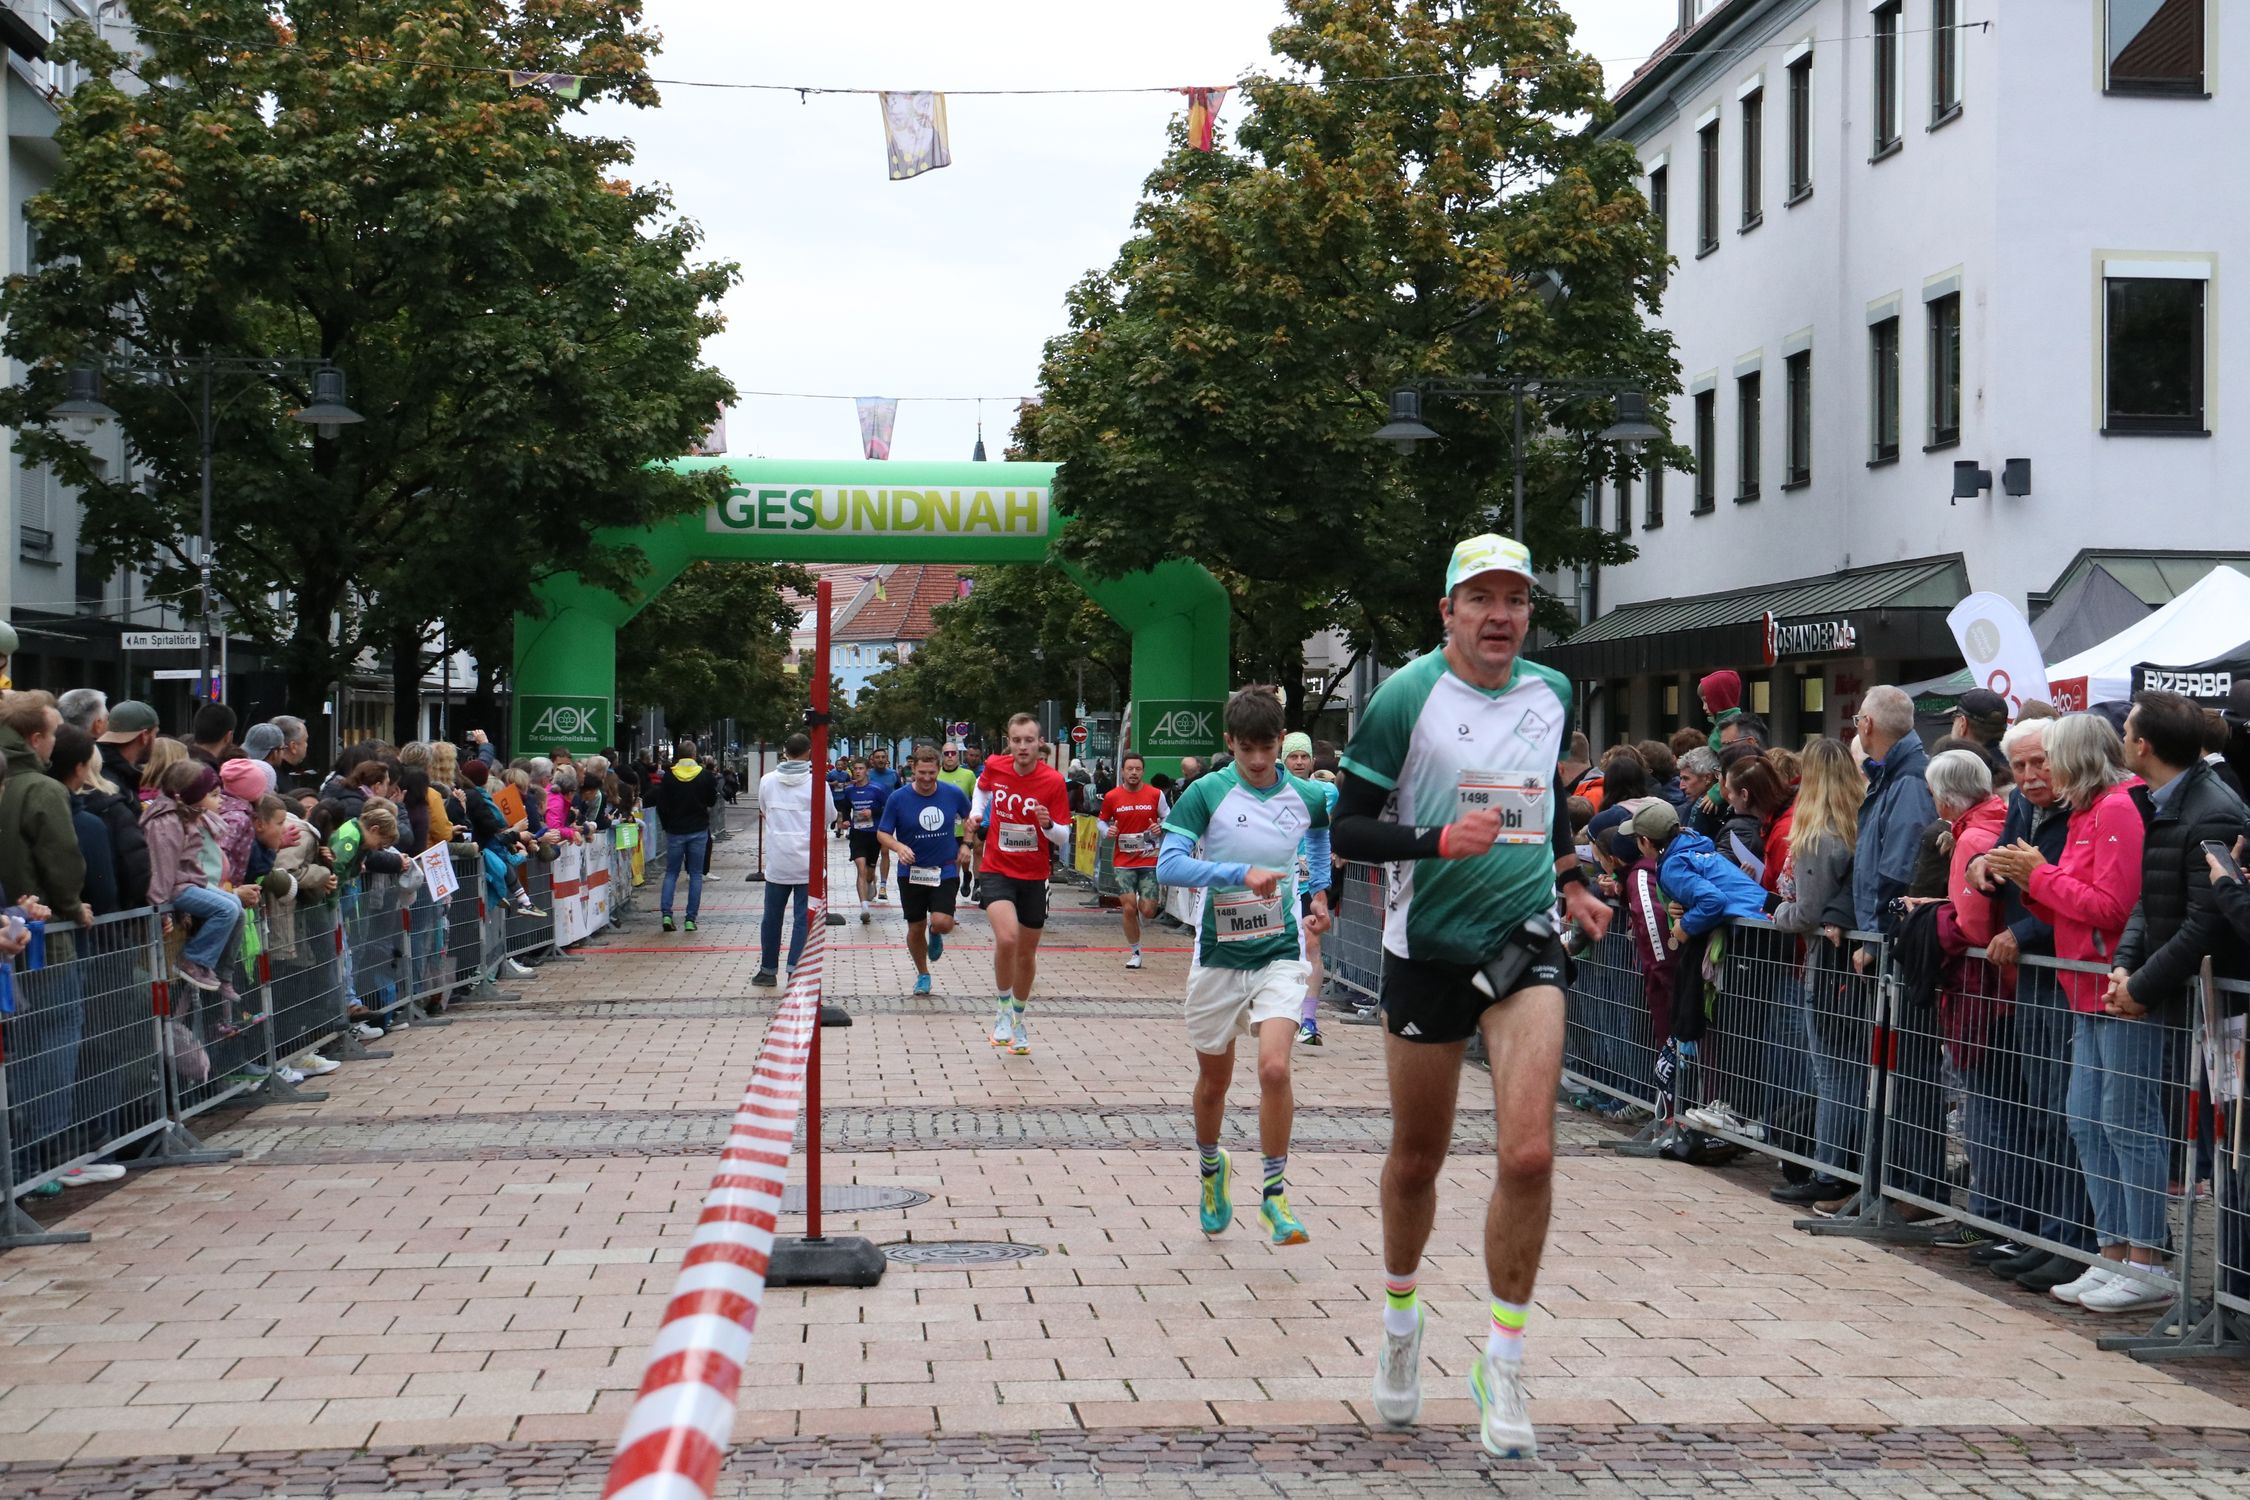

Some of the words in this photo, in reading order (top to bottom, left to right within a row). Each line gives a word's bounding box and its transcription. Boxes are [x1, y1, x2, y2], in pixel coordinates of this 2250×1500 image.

[717, 487, 1038, 532] GESUNDNAH
[133, 635, 147, 645] Am
[151, 635, 197, 648] Spitaltörle
[2143, 670, 2231, 697] BIZERBA
[531, 706, 597, 734] AOK
[1150, 710, 1214, 738] AOK
[529, 734, 539, 742] Die
[1461, 792, 1489, 804] 1498
[1003, 837, 1032, 847] Jannis
[1216, 908, 1237, 917] 1488
[1230, 913, 1268, 931] Matti
